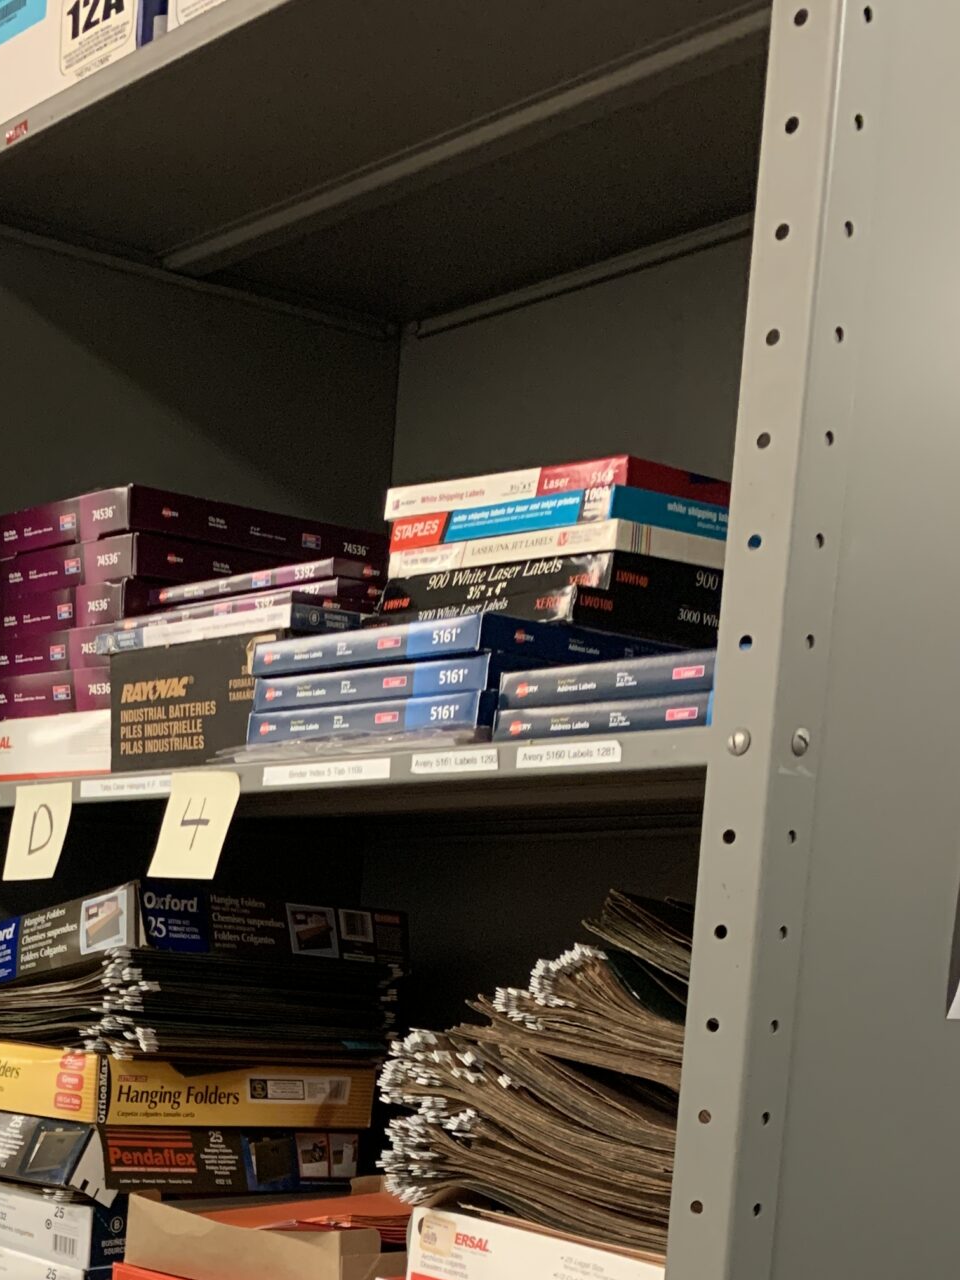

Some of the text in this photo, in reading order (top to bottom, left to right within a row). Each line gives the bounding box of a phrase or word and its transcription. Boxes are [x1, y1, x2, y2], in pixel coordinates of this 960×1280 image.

[544, 477, 568, 489] Laser
[92, 506, 113, 522] 74536
[394, 519, 439, 540] STAPLES
[97, 554, 118, 567] 74536
[294, 566, 315, 580] 5392
[427, 559, 563, 590] 900 White Laser Labels
[696, 570, 719, 591] 900
[88, 600, 108, 612] 74536
[433, 629, 457, 644] 5161
[81, 643, 96, 654] 7453
[439, 670, 463, 684] 5161
[88, 683, 111, 695] 74536
[120, 676, 189, 704] RAYOVAC
[516, 682, 539, 698] AVERY
[557, 682, 596, 693] Address Labels
[120, 700, 217, 725] INDUSTRIAL BATTERIES
[430, 706, 454, 721] 5161
[120, 718, 203, 739] PILES INDUSTRIELLE
[509, 720, 532, 736] AVERY
[550, 721, 589, 731] Address Labels
[120, 735, 205, 755] PILAS INDUSTRIALES
[455, 756, 477, 766] Labels
[522, 752, 544, 762] Avery
[568, 749, 593, 759] Labels
[597, 746, 615, 757] 1281
[27, 802, 54, 856] D
[180, 796, 211, 851] 4
[144, 891, 197, 913] Oxford
[24, 908, 66, 927] Hanging Folders
[22, 923, 78, 945] Chemises suspendues
[148, 916, 166, 938] 25
[214, 931, 240, 942] Folders
[20, 952, 39, 963] Folders
[40, 944, 67, 958] Colgantes
[98, 1058, 108, 1123] OfficeMax
[117, 1085, 240, 1110] Hanging Folders
[209, 1131, 223, 1143] 25
[110, 1147, 196, 1168] Pendaflex
[54, 1206, 65, 1220] 25
[46, 1268, 57, 1280] 25
